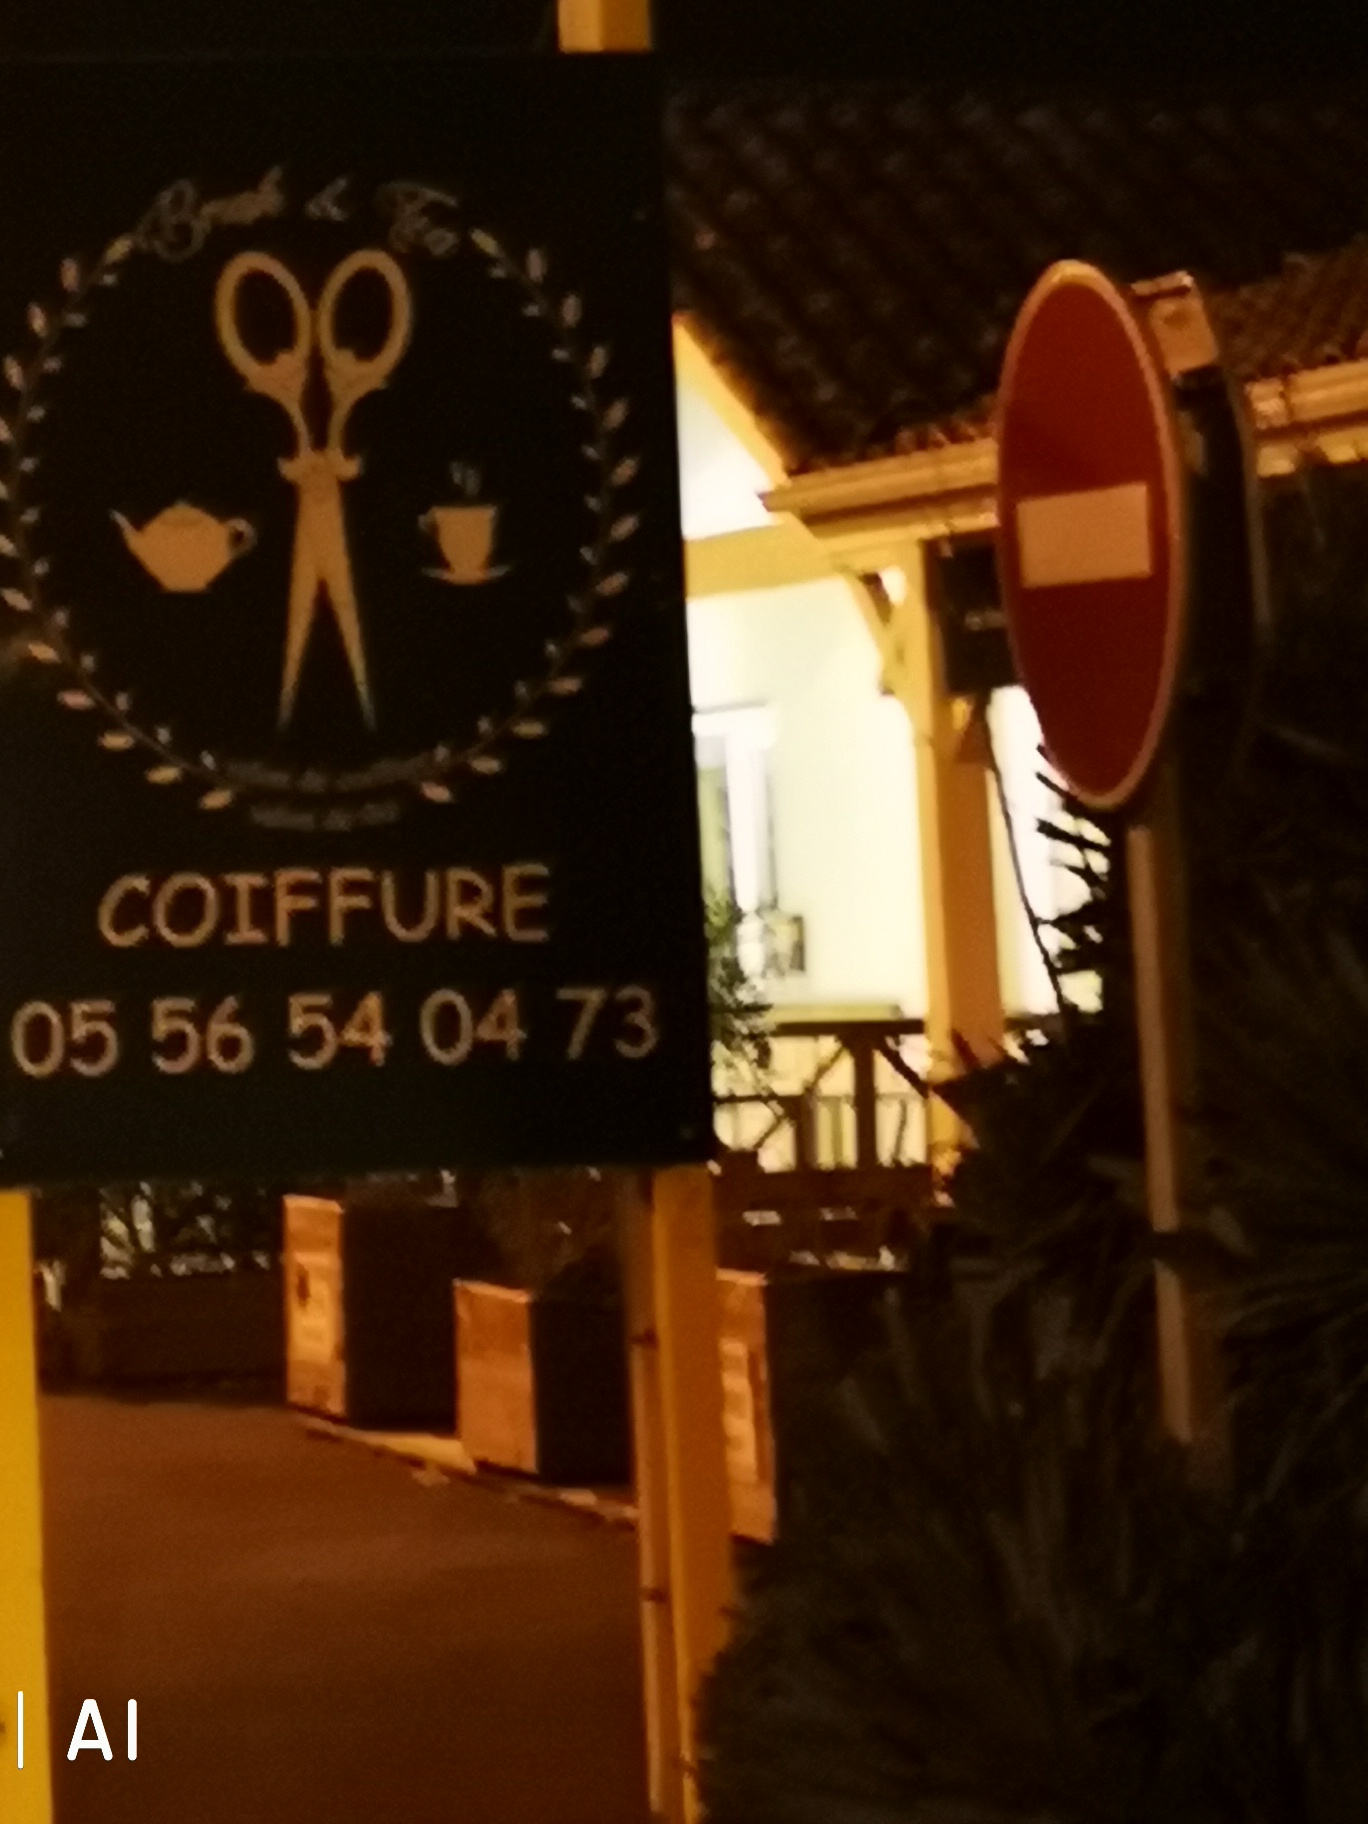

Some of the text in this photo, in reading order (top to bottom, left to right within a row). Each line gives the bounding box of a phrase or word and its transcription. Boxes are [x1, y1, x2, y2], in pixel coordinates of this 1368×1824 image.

[98, 864, 548, 948] COIFFURE
[10, 987, 656, 1078] 05 56 54 04 73
